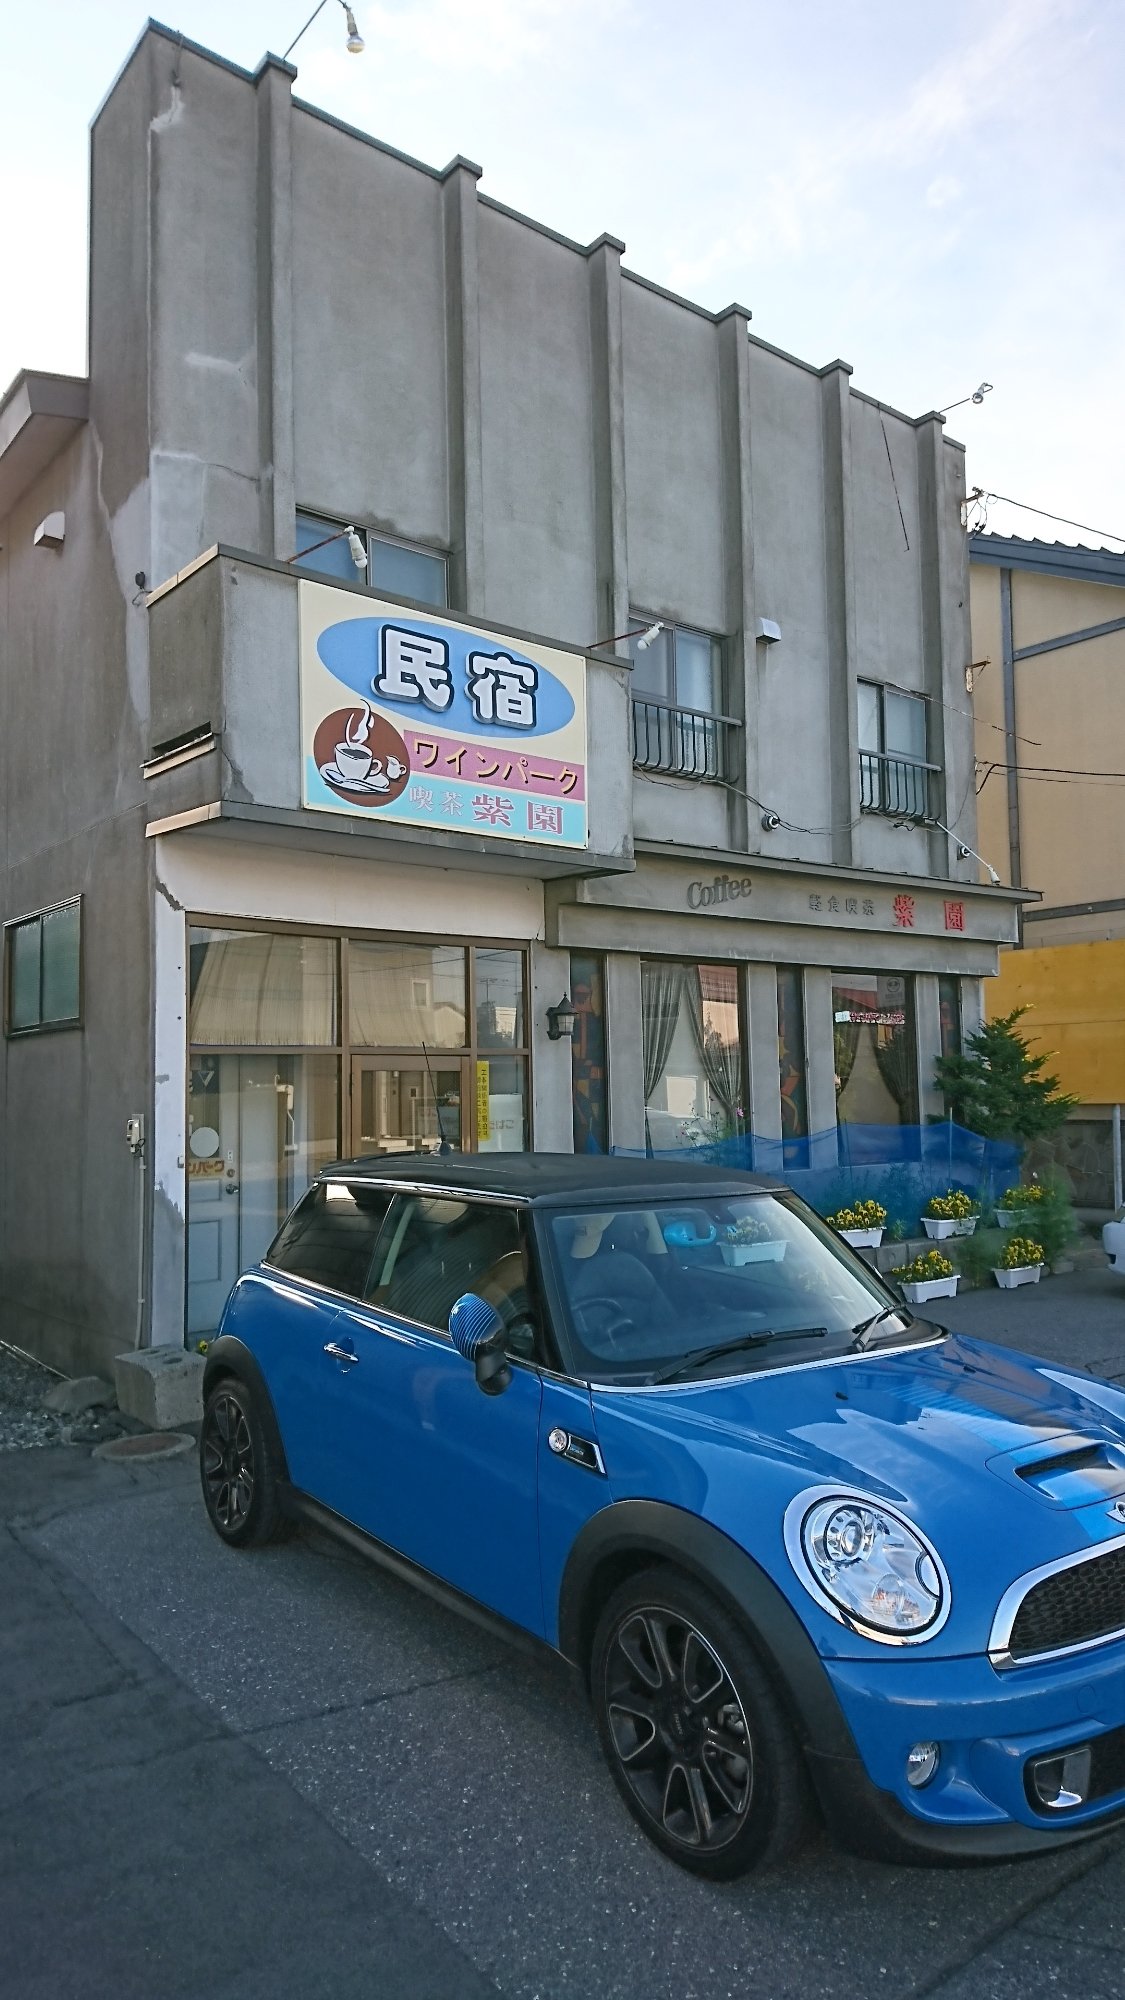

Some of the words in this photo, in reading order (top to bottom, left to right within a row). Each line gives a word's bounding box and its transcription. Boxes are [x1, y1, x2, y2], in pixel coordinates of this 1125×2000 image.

[370, 623, 540, 730] 民宿
[413, 738, 579, 796] ワインパーク
[409, 785, 465, 817] 喫茶
[472, 792, 565, 835] 紫園
[687, 874, 752, 910] Coffee
[893, 893, 965, 932] 紫園
